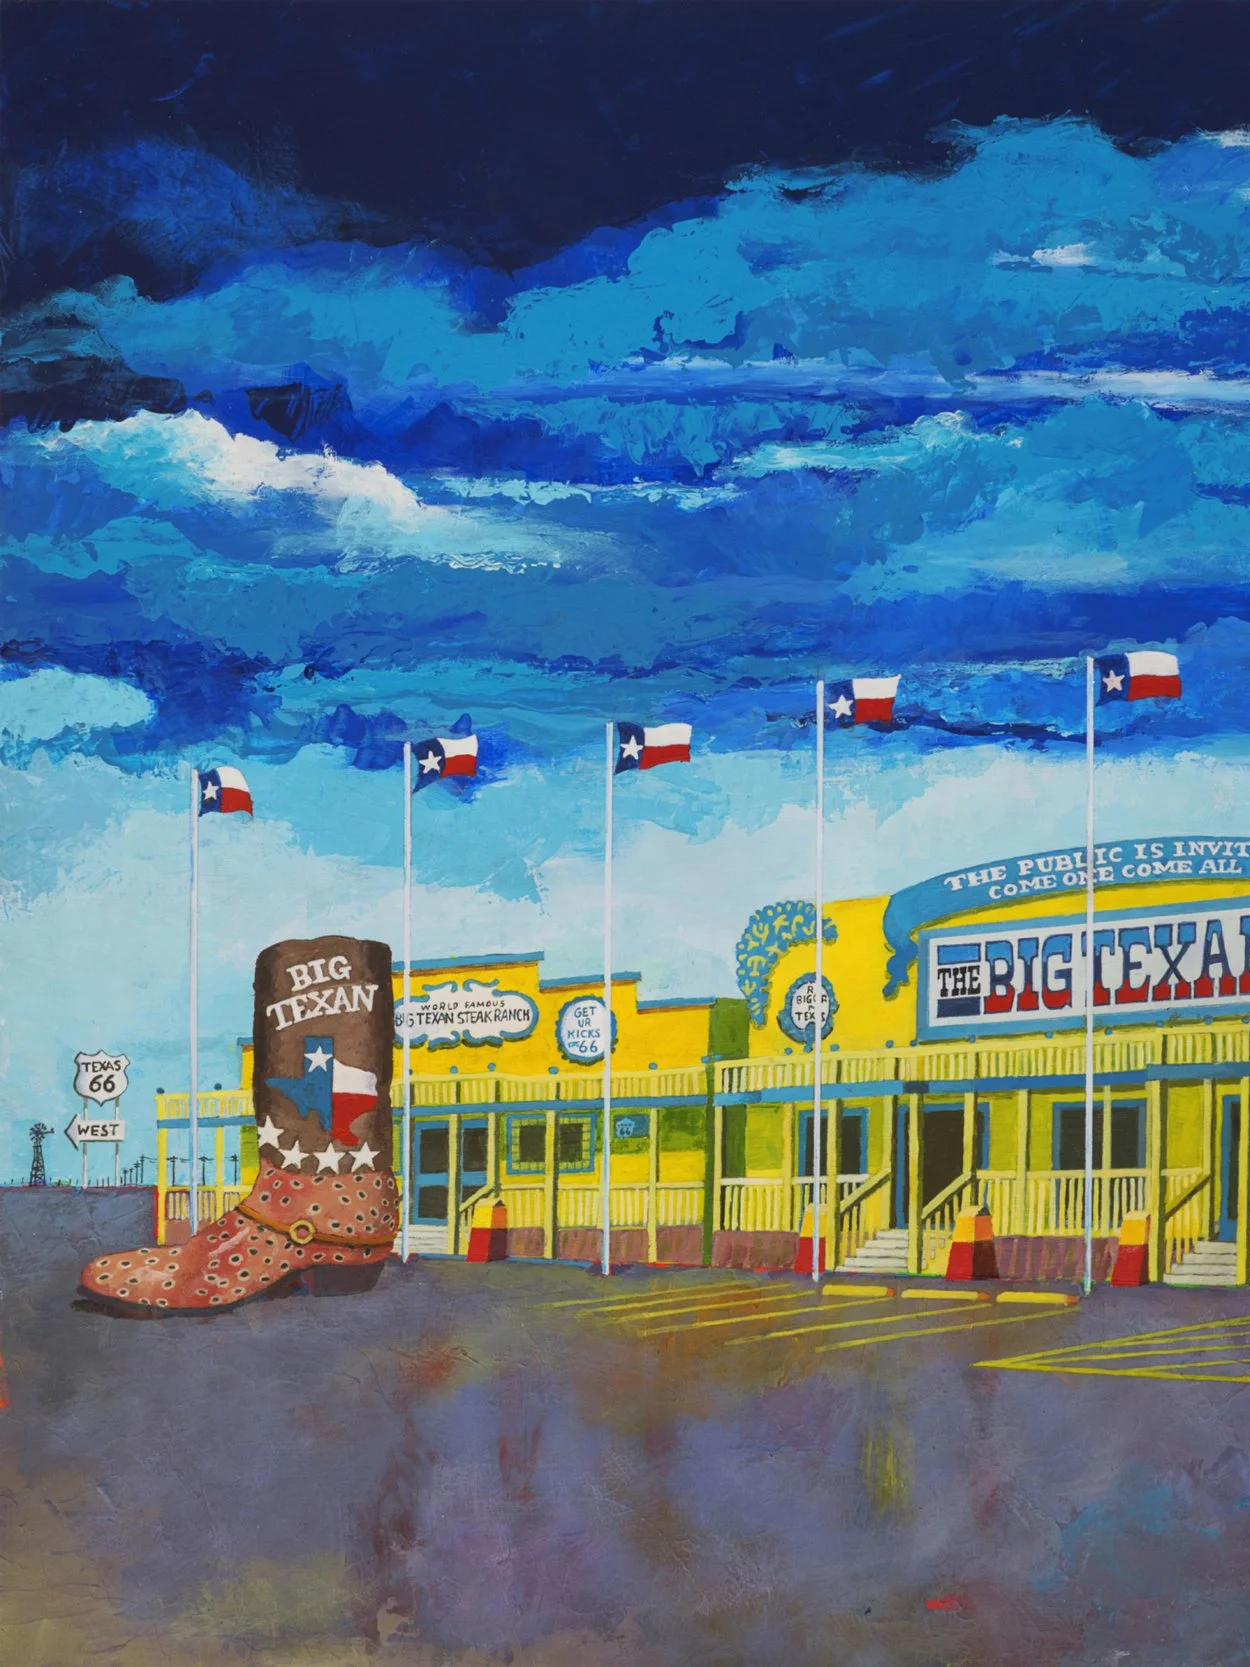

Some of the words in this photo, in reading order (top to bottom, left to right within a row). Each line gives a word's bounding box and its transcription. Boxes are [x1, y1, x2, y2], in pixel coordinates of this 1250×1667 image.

[944, 865, 1007, 891] THE
[1017, 847, 1123, 876] PUBLIC
[1134, 843, 1164, 860] IS
[988, 874, 1058, 899] COME
[1062, 866, 1114, 886] ONE
[1121, 860, 1193, 878] COME
[1198, 859, 1243, 874] ALL
[286, 955, 352, 992] BIG
[937, 965, 981, 998] THE
[983, 933, 1073, 1014] BIG
[266, 984, 379, 1031] TEXAN
[421, 1002, 458, 1011] WORLD
[465, 1000, 505, 1009] FAMOUS
[574, 1006, 597, 1018] GET
[416, 1011, 454, 1026] TEXAN
[457, 1010, 493, 1025] STEAK
[494, 1008, 531, 1022] RANCH
[578, 1017, 591, 1028] UR
[795, 1012, 825, 1022] TEXS
[567, 1028, 601, 1039] KICKS
[579, 1040, 598, 1053] 66
[81, 1060, 121, 1073] TEXAS
[89, 1074, 116, 1093] 66
[77, 1123, 120, 1137] WEST
